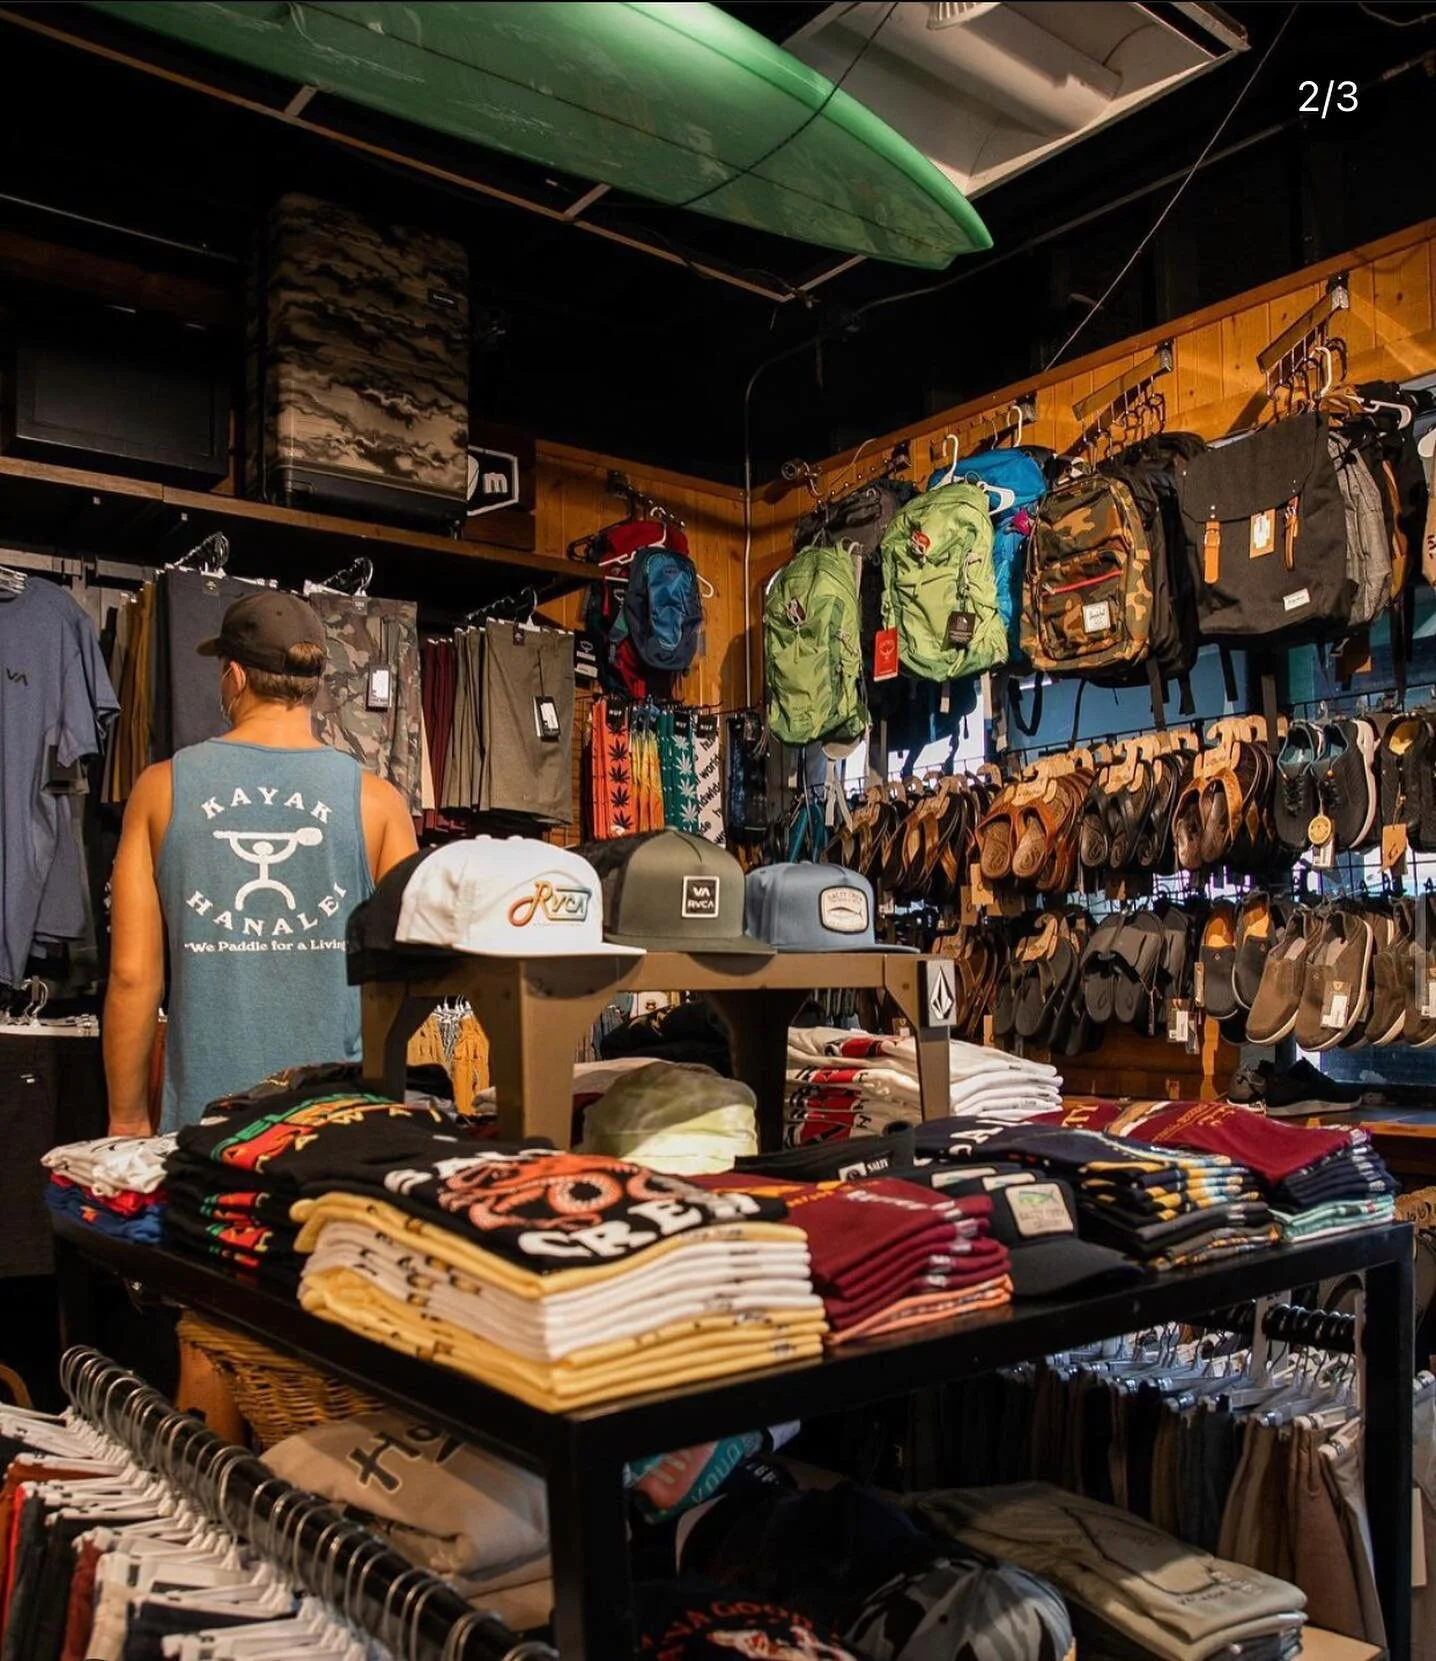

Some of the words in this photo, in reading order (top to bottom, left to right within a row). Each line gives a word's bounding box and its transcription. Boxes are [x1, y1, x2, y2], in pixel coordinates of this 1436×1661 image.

[201, 787, 333, 824] KAYAK
[186, 882, 347, 936] HANALEI
[687, 899, 714, 909] RVCA
[218, 941, 268, 952] Paddle
[271, 940, 293, 951] for
[297, 941, 308, 951] a
